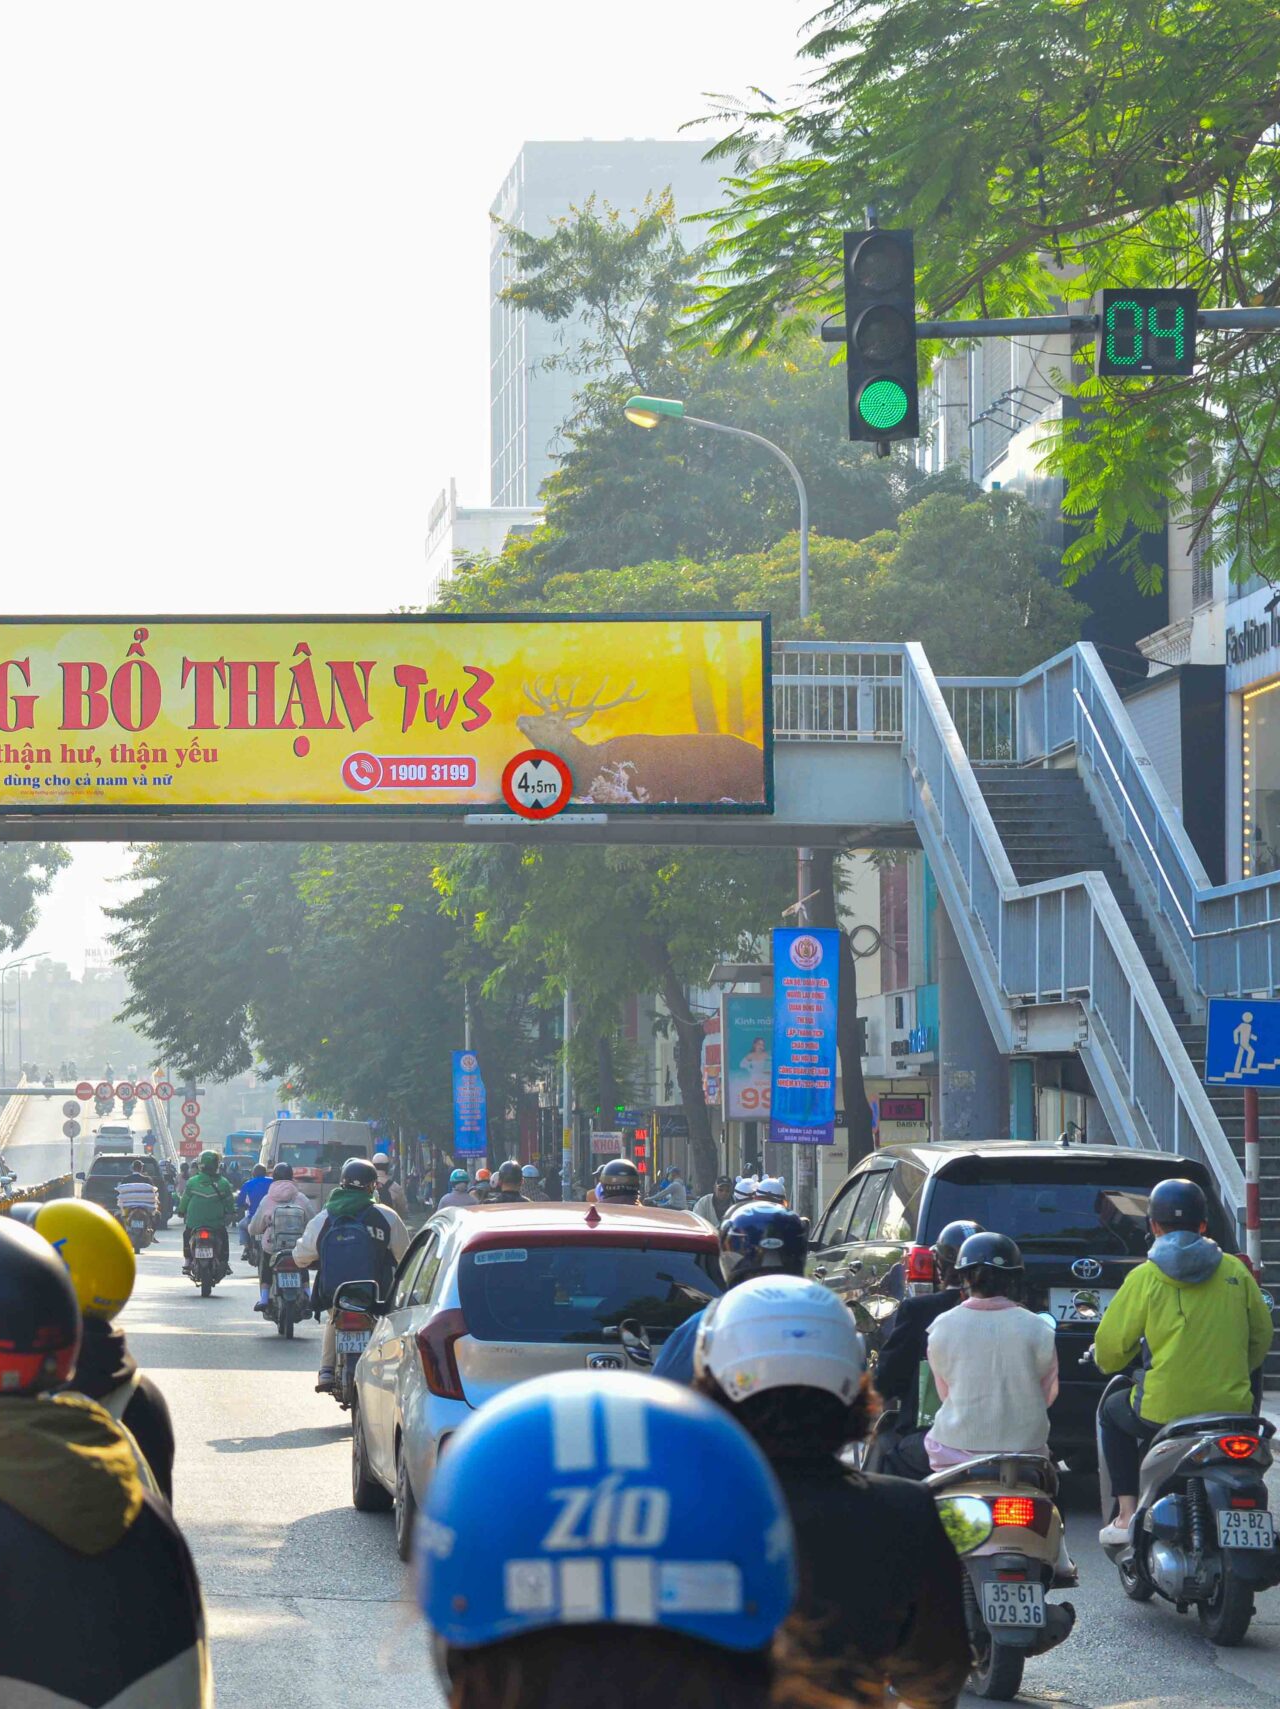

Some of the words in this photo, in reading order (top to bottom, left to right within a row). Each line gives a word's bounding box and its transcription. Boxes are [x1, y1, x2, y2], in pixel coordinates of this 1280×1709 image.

[1106, 301, 1184, 365] 04
[1225, 618, 1269, 667] Fashion
[57, 628, 162, 732] BỔ
[180, 642, 378, 757] THẬN
[393, 664, 495, 733] Tw3
[60, 743, 102, 768] hư,
[110, 741, 168, 770] thận
[175, 736, 219, 768] yếu
[4, 773, 41, 788] dùng
[45, 775, 71, 786] cho
[75, 773, 92, 786] cả
[96, 777, 128, 786] nam
[132, 774, 148, 786] và
[152, 773, 173, 786] nữ
[390, 765, 426, 780] 1900
[431, 765, 469, 780] 3199
[517, 772, 557, 795] 4,5m
[1226, 1512, 1265, 1529] 29-B2
[1222, 1530, 1271, 1547] 213.13
[992, 1584, 1034, 1603] 35-G1
[988, 1605, 1042, 1624] 029.36
